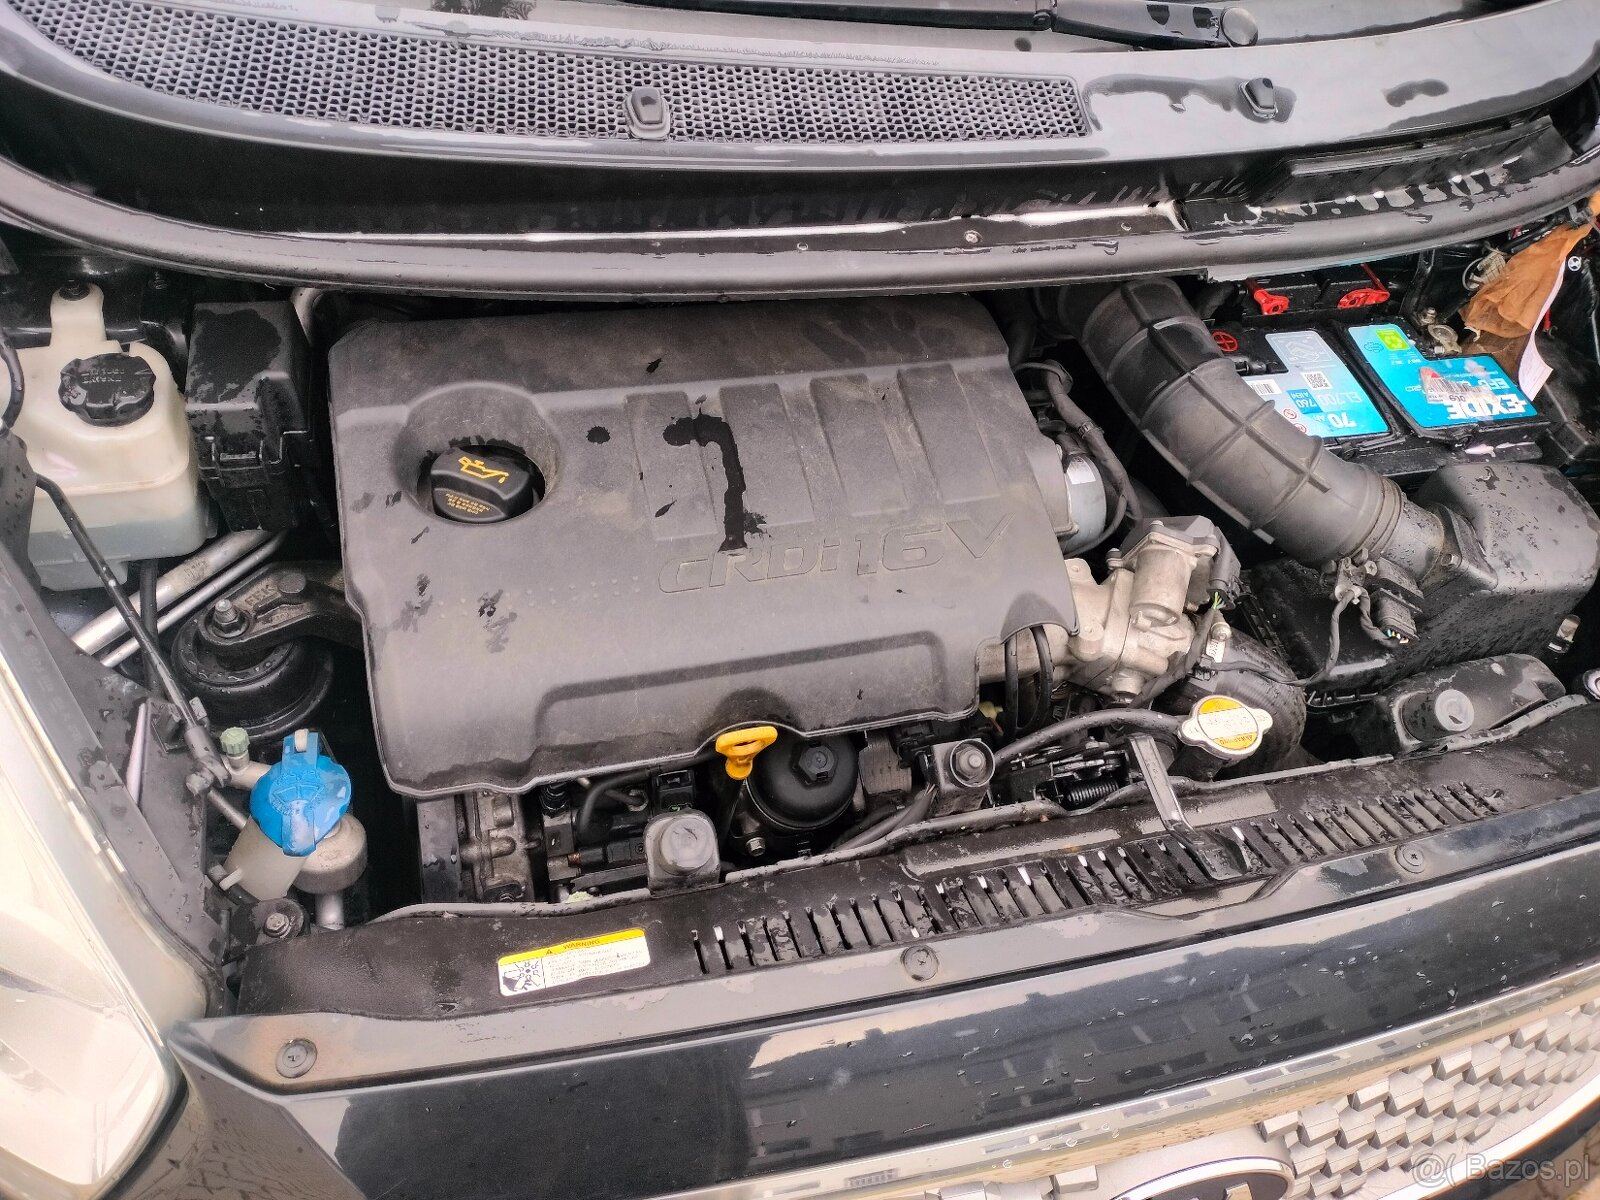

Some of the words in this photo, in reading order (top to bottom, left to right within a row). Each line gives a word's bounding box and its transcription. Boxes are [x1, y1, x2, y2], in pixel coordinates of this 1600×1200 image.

[1296, 399, 1317, 408] 760
[1446, 393, 1528, 420] EXIDE
[1327, 411, 1358, 429] 70
[854, 511, 1016, 576] 16V
[563, 939, 600, 950] WARNING
